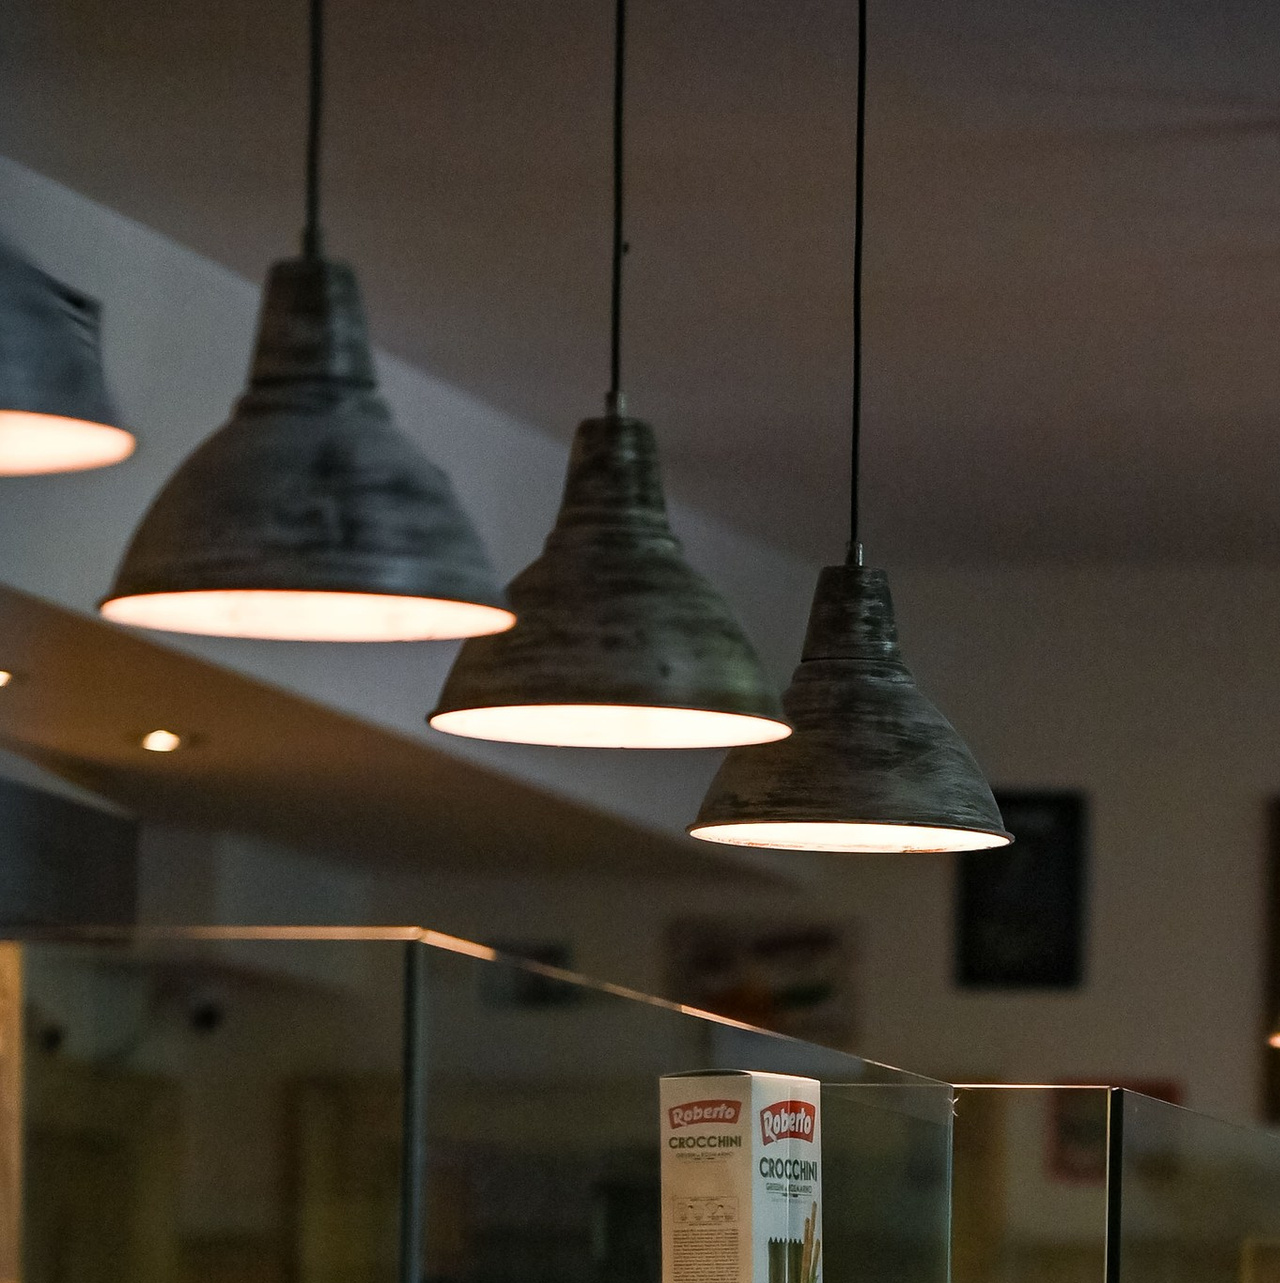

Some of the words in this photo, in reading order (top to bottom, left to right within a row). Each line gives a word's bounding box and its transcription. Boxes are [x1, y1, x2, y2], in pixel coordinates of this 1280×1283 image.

[672, 1104, 736, 1127] Roberto
[763, 1107, 812, 1141] Roberto
[668, 1135, 742, 1149] CROCCHINI
[760, 1156, 818, 1182] CROCCHINI
